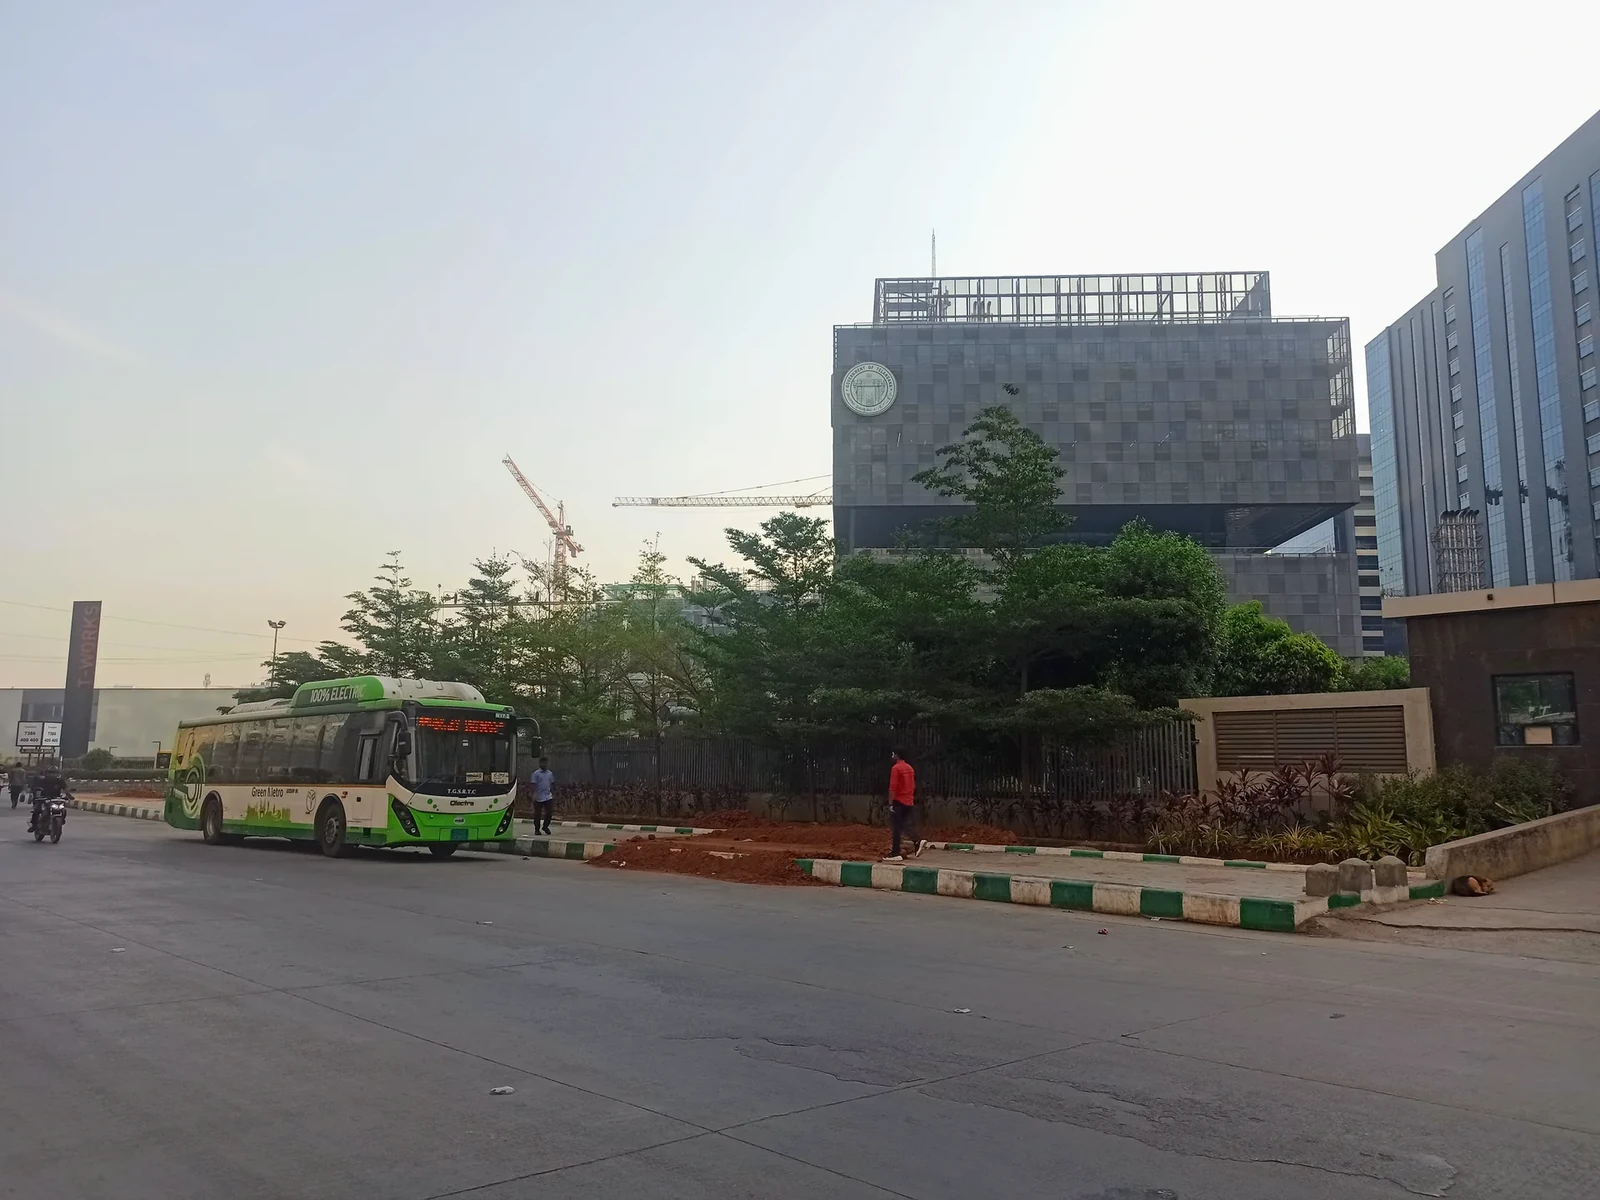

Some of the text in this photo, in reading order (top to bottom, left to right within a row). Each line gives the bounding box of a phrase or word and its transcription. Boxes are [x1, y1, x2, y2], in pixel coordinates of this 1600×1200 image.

[76, 606, 99, 688] T-WORKS
[310, 684, 367, 703] 100% ELECTRIC
[251, 786, 267, 798] Green
[267, 786, 284, 798] Metro
